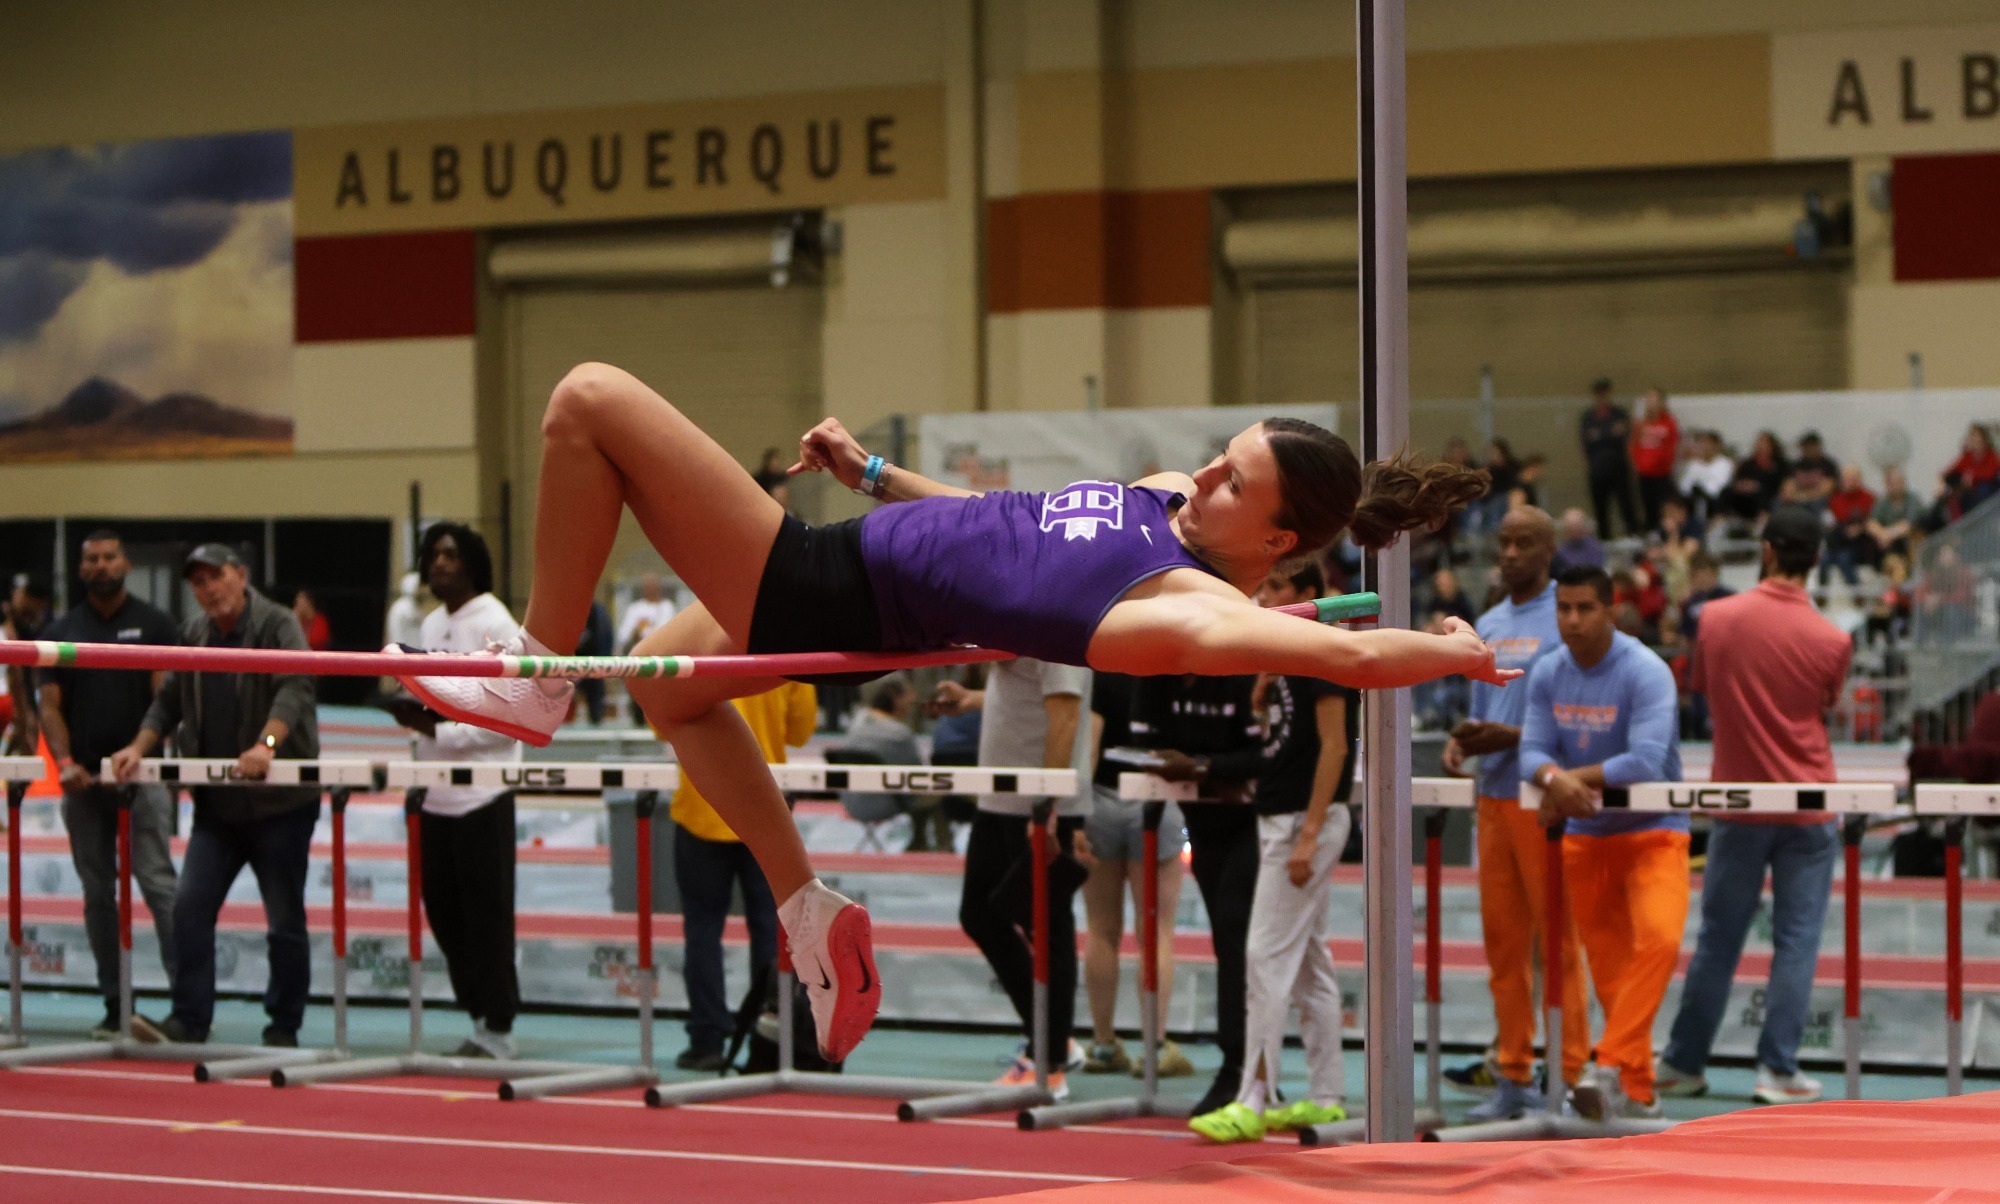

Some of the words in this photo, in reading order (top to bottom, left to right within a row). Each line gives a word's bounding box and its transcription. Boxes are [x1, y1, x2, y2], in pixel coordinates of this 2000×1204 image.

[336, 116, 897, 208] ALBUQUERQUE
[502, 768, 566, 785] UCS
[882, 771, 953, 790] UCS
[1668, 789, 1751, 808] UCS
